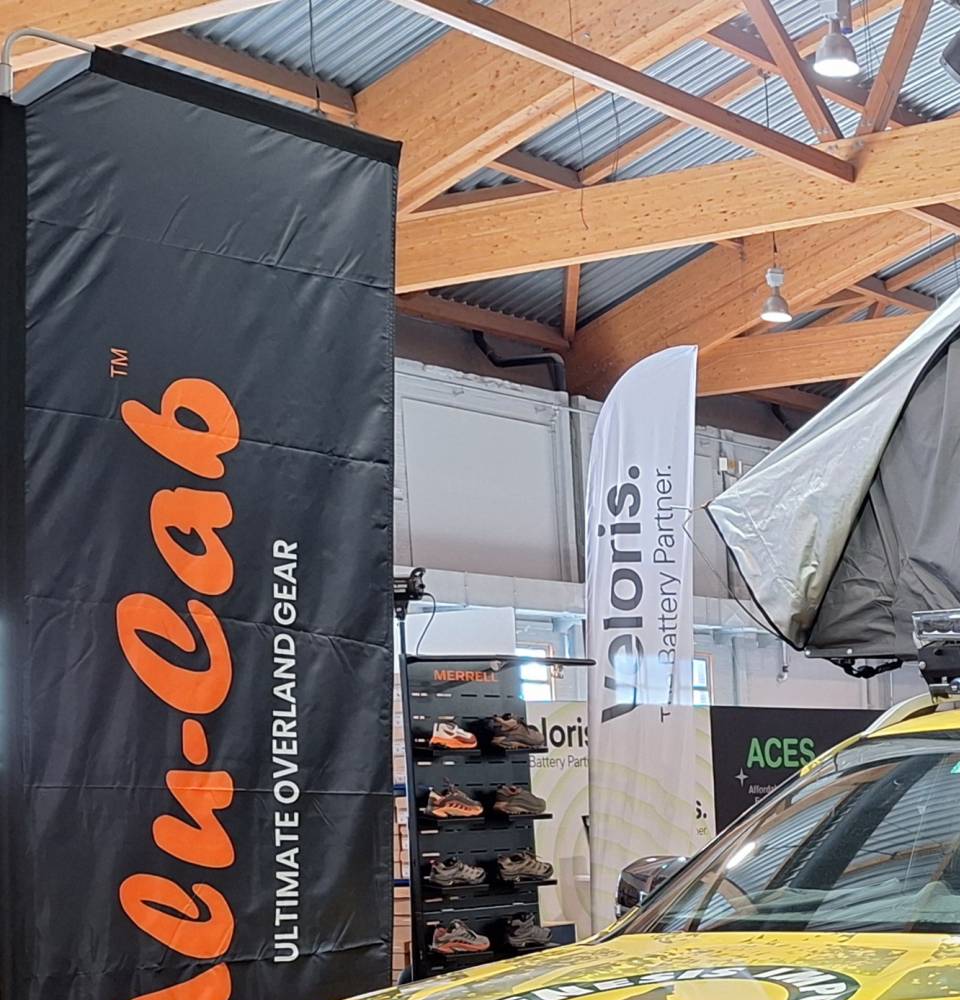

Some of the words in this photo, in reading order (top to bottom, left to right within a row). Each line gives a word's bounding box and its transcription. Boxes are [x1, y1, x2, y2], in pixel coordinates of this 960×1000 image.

[653, 464, 677, 564] Partner.
[272, 538, 298, 628] GEAR
[657, 571, 682, 665] Battery
[272, 633, 300, 803] OVERLAND
[434, 669, 499, 682] MERRELL
[529, 756, 566, 769] Battery
[746, 737, 817, 769] ACES
[272, 811, 300, 963] ULTIMATE
